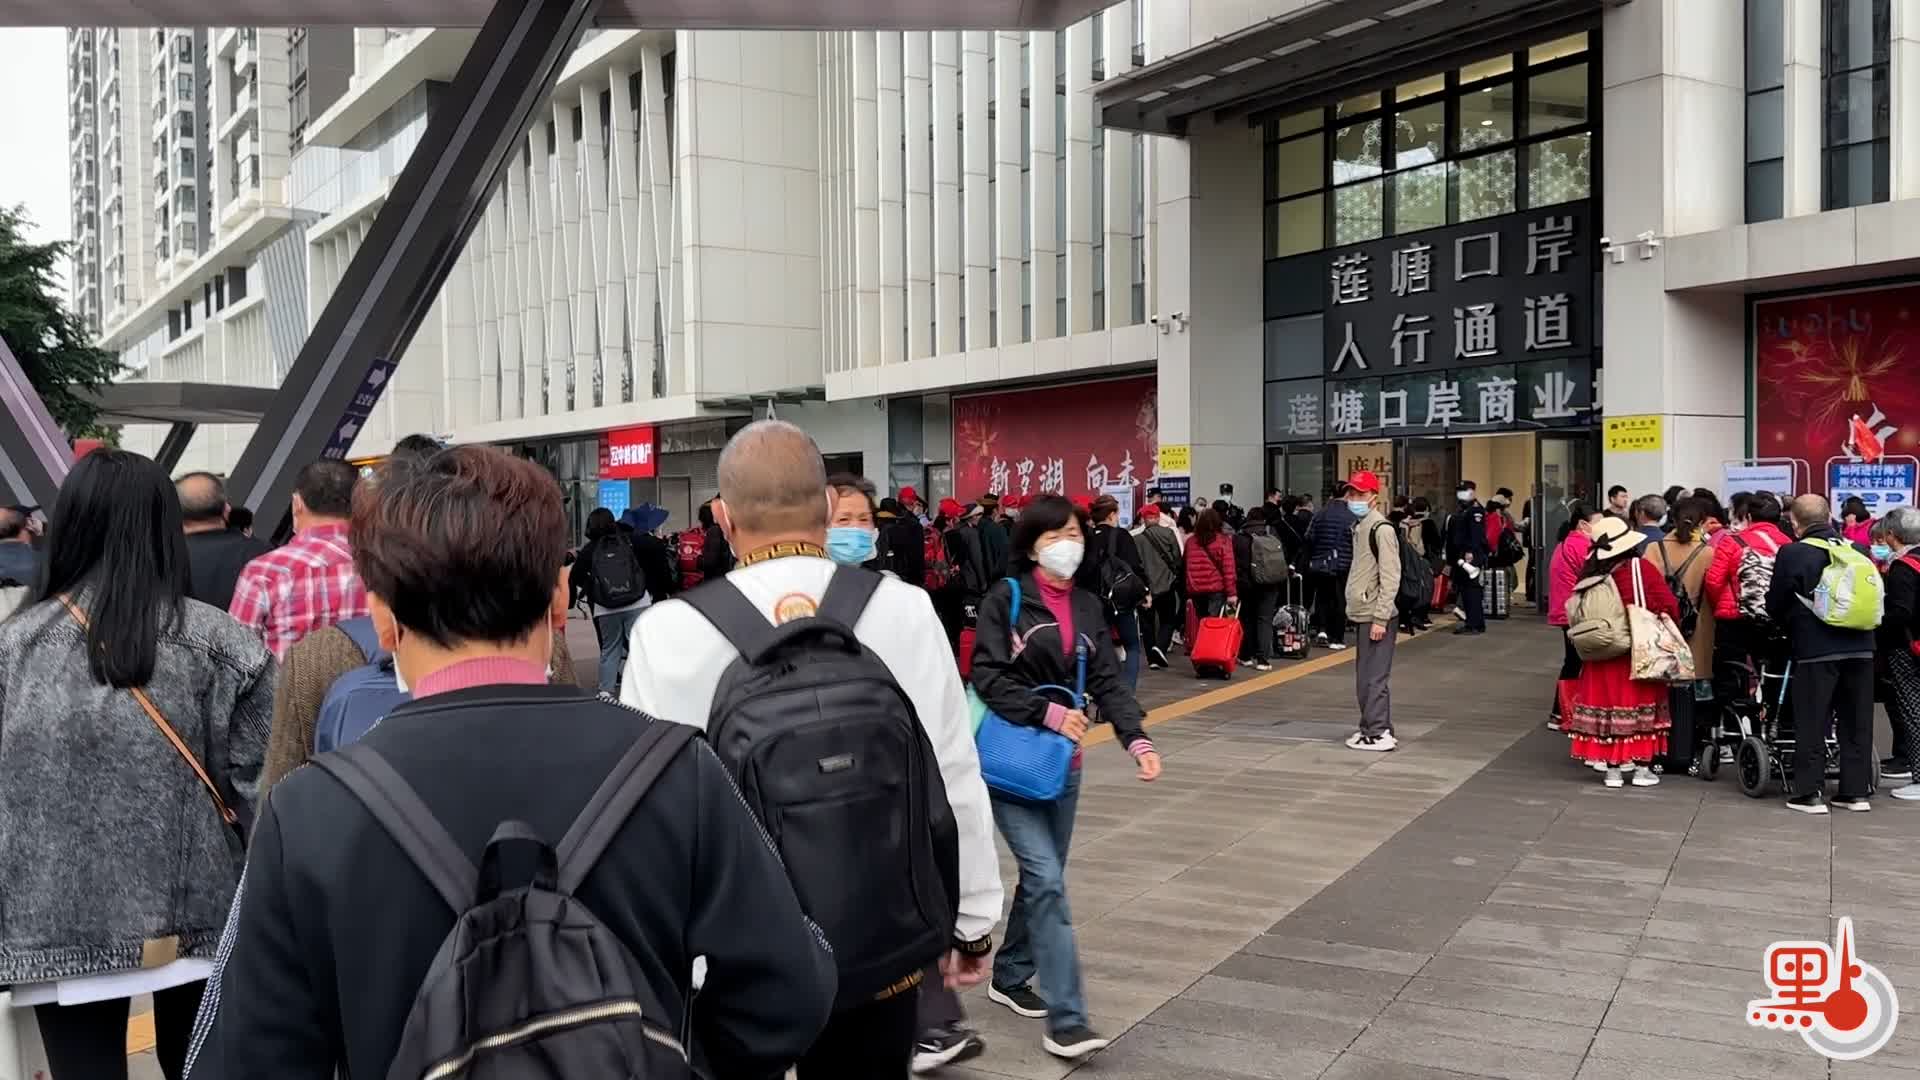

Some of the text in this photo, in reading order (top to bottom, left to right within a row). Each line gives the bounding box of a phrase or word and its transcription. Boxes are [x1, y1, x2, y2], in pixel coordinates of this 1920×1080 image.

[1331, 215, 1573, 305] 莲塘口岸
[1331, 293, 1573, 373] 人行通道
